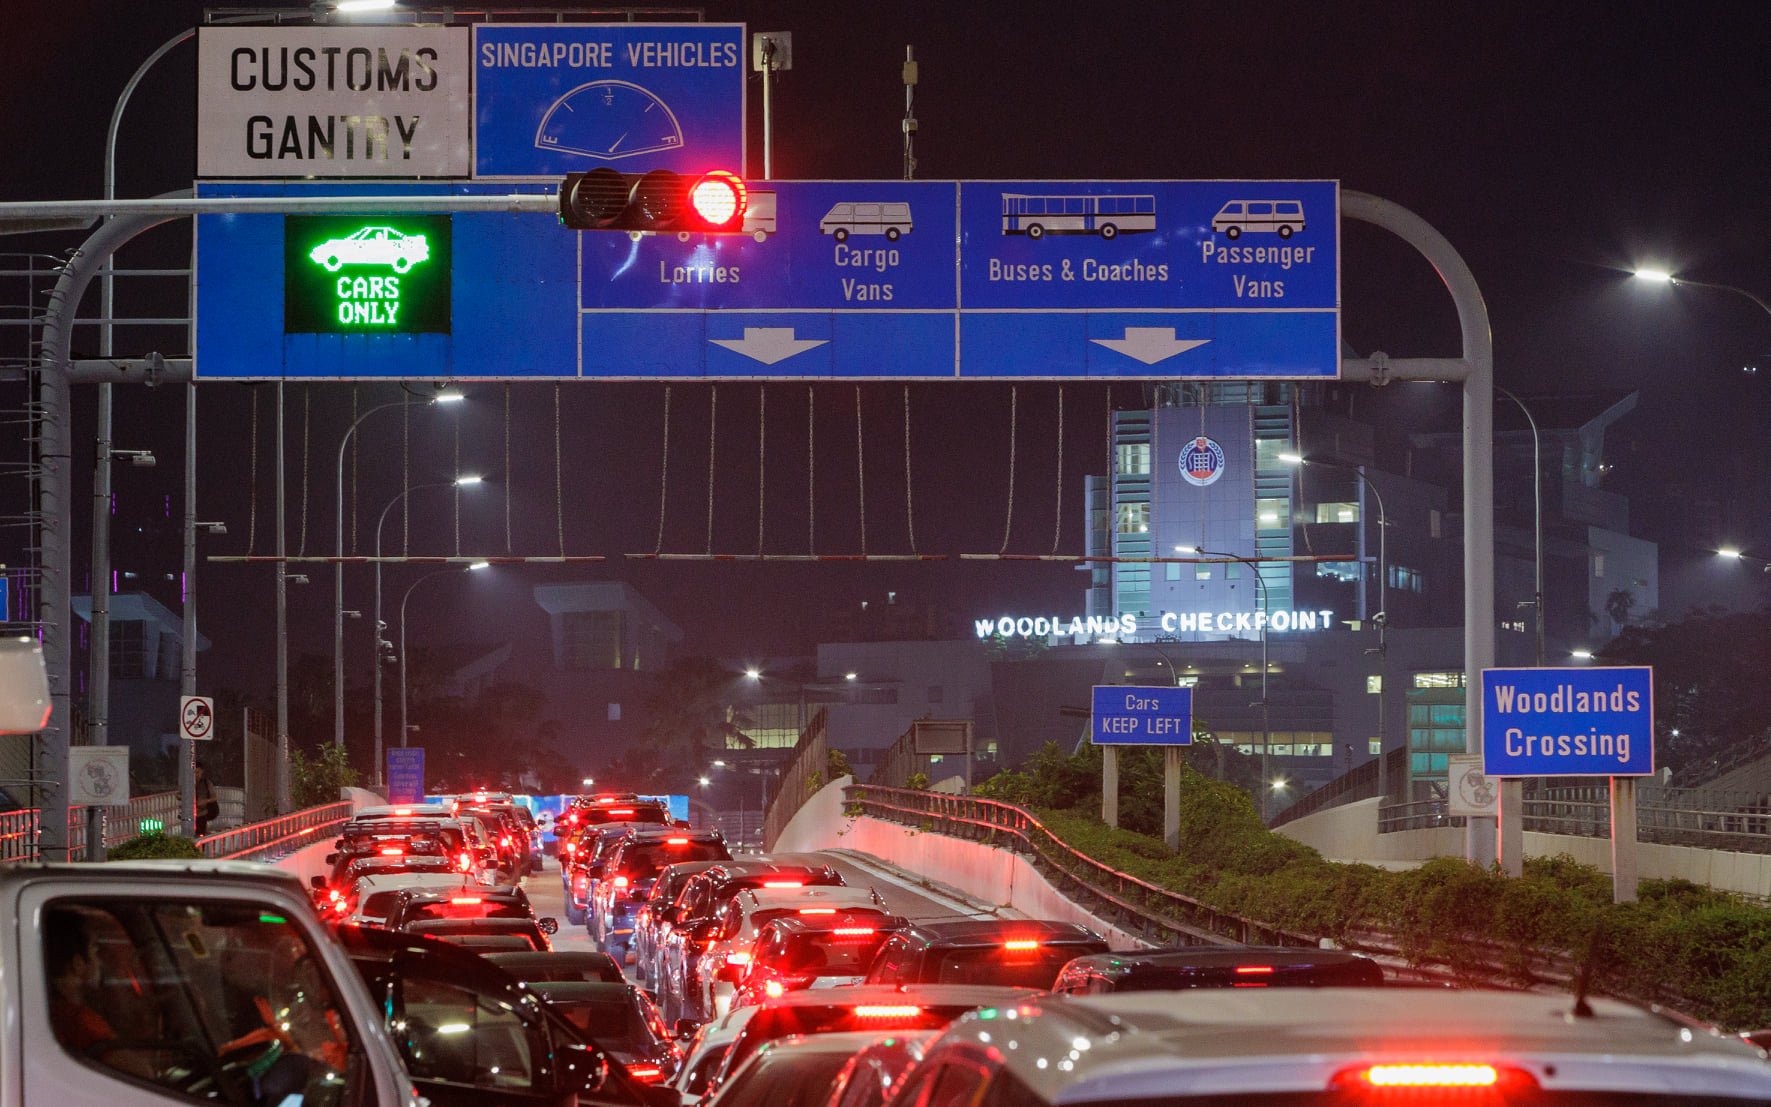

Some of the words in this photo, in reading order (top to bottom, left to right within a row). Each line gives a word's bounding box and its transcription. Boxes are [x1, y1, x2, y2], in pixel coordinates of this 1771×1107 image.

[482, 43, 612, 68] SINGAPORE
[628, 42, 737, 67] VEHICLES
[231, 47, 438, 91] CUSTOMS
[247, 115, 420, 160] GANTRY
[835, 244, 900, 272] Cargo
[1203, 241, 1316, 270] Passenger
[660, 260, 741, 284] Lorries
[989, 258, 1052, 281] Buses
[1061, 258, 1075, 281] &
[1083, 258, 1169, 281] Coaches
[336, 275, 400, 300] CARS
[842, 277, 894, 301] Vans
[1233, 275, 1285, 298] Vans
[337, 300, 400, 325] ONLY
[975, 614, 1137, 638] WOODLANDS
[1161, 608, 1334, 633] CHECKPOINT
[1125, 694, 1160, 710] Cars
[1495, 684, 1641, 713] Woodlands
[1102, 717, 1139, 734] KEEP
[1147, 717, 1181, 735] LEFT
[1505, 727, 1631, 763] Crossing
